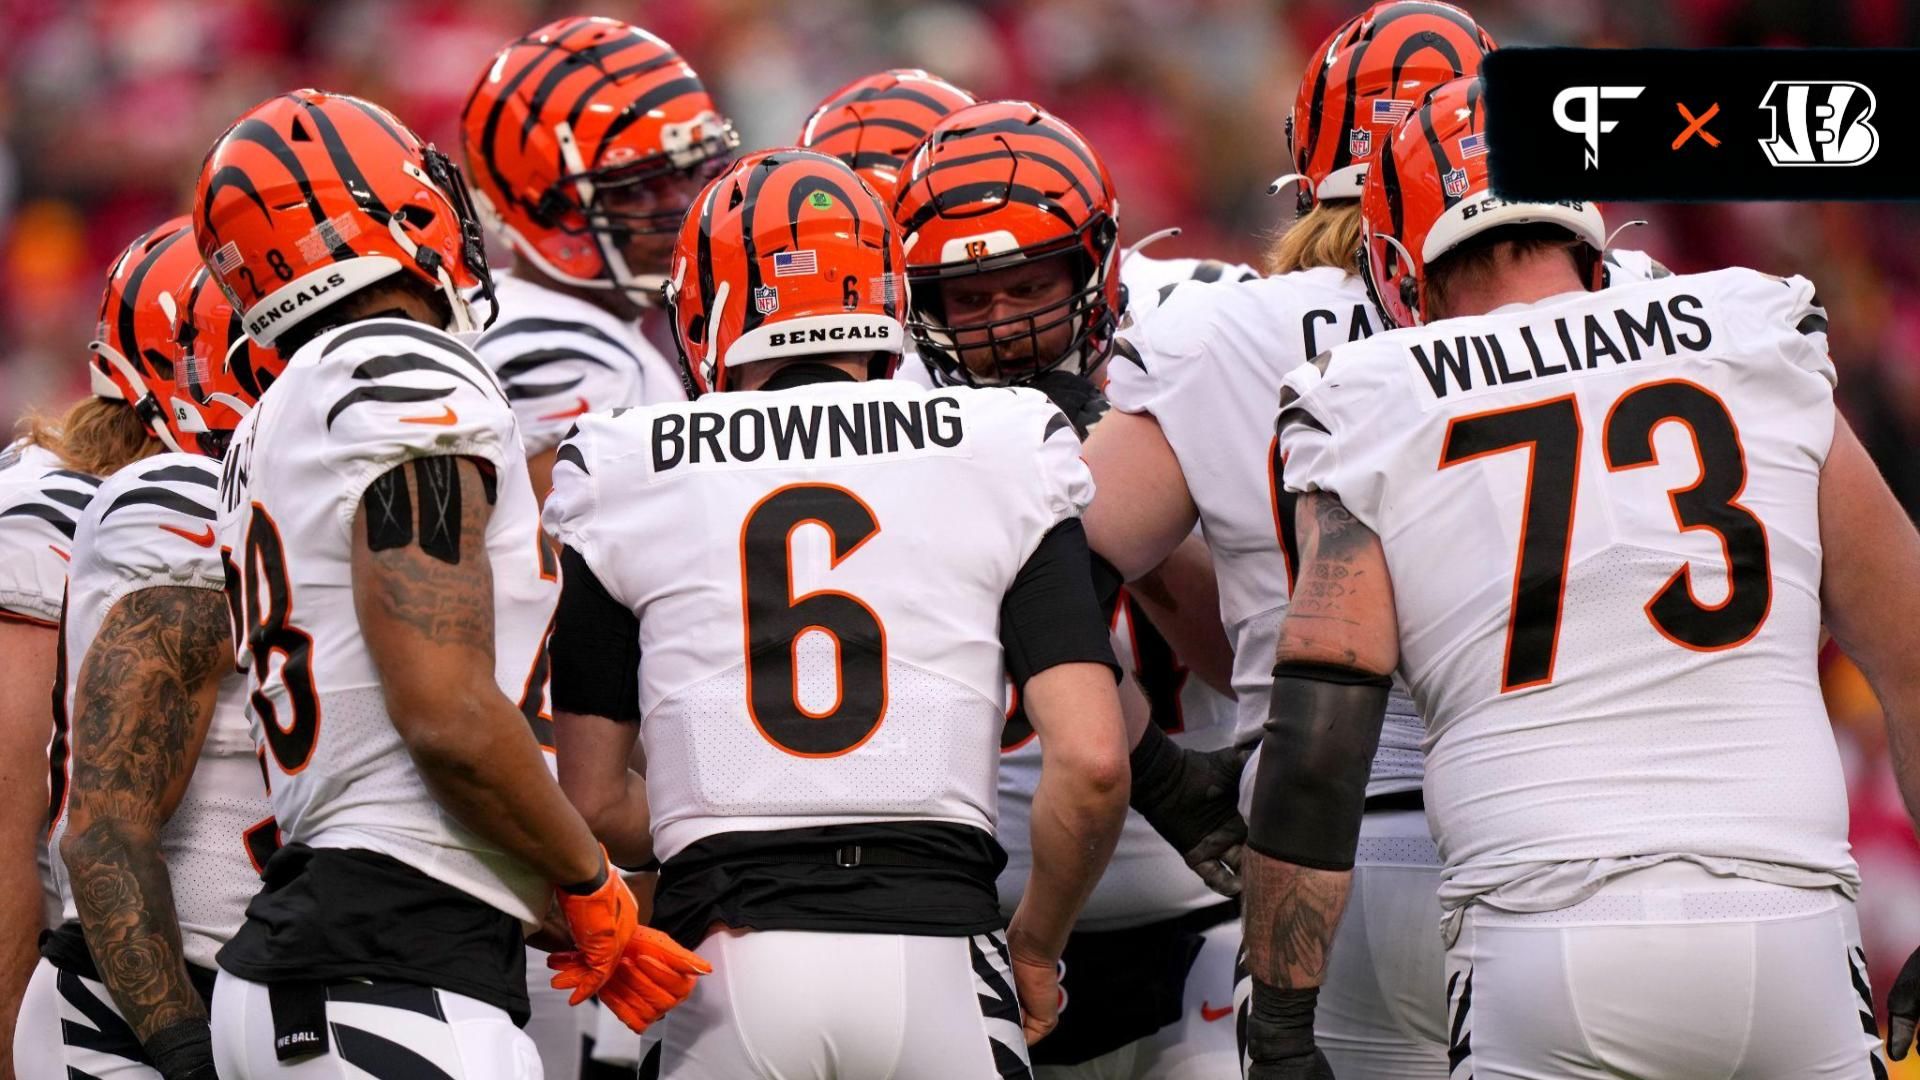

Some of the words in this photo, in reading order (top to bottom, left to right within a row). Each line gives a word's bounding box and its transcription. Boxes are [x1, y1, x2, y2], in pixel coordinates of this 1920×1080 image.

[249, 273, 346, 336] BENGALS
[842, 275, 860, 311] 6
[769, 326, 889, 347] BENGALS
[1409, 293, 1713, 398] WILLIAMS
[651, 396, 964, 473] BROWNING
[1438, 377, 1772, 694] 73
[740, 481, 888, 759] 6
[277, 1035, 290, 1048] WE
